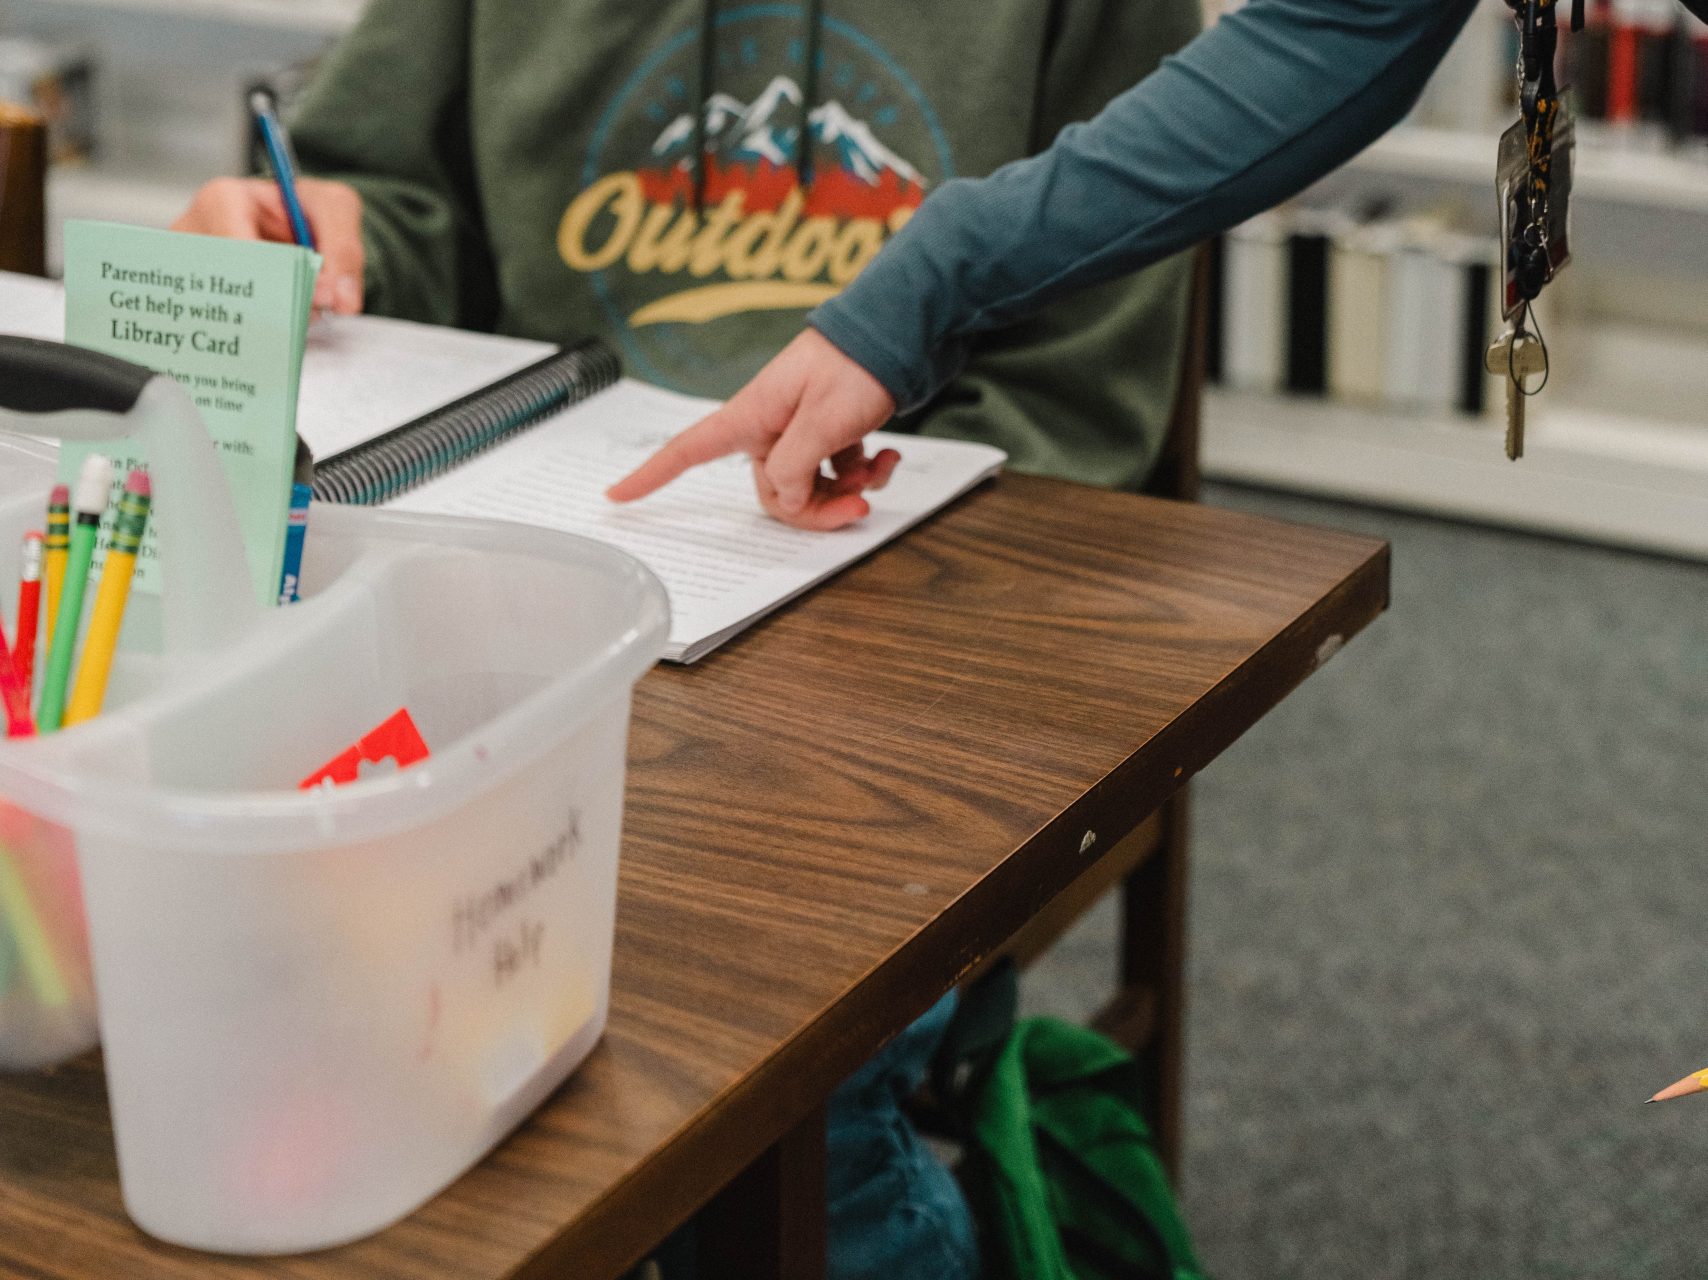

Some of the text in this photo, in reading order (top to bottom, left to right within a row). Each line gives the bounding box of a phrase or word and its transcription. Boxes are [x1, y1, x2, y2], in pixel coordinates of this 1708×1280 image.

[101, 262, 255, 298] Parenting is Hard
[109, 291, 242, 325] Get help with a
[110, 319, 241, 356] Library Card
[194, 376, 218, 390] you
[221, 376, 256, 397] bring
[195, 396, 243, 413] on time
